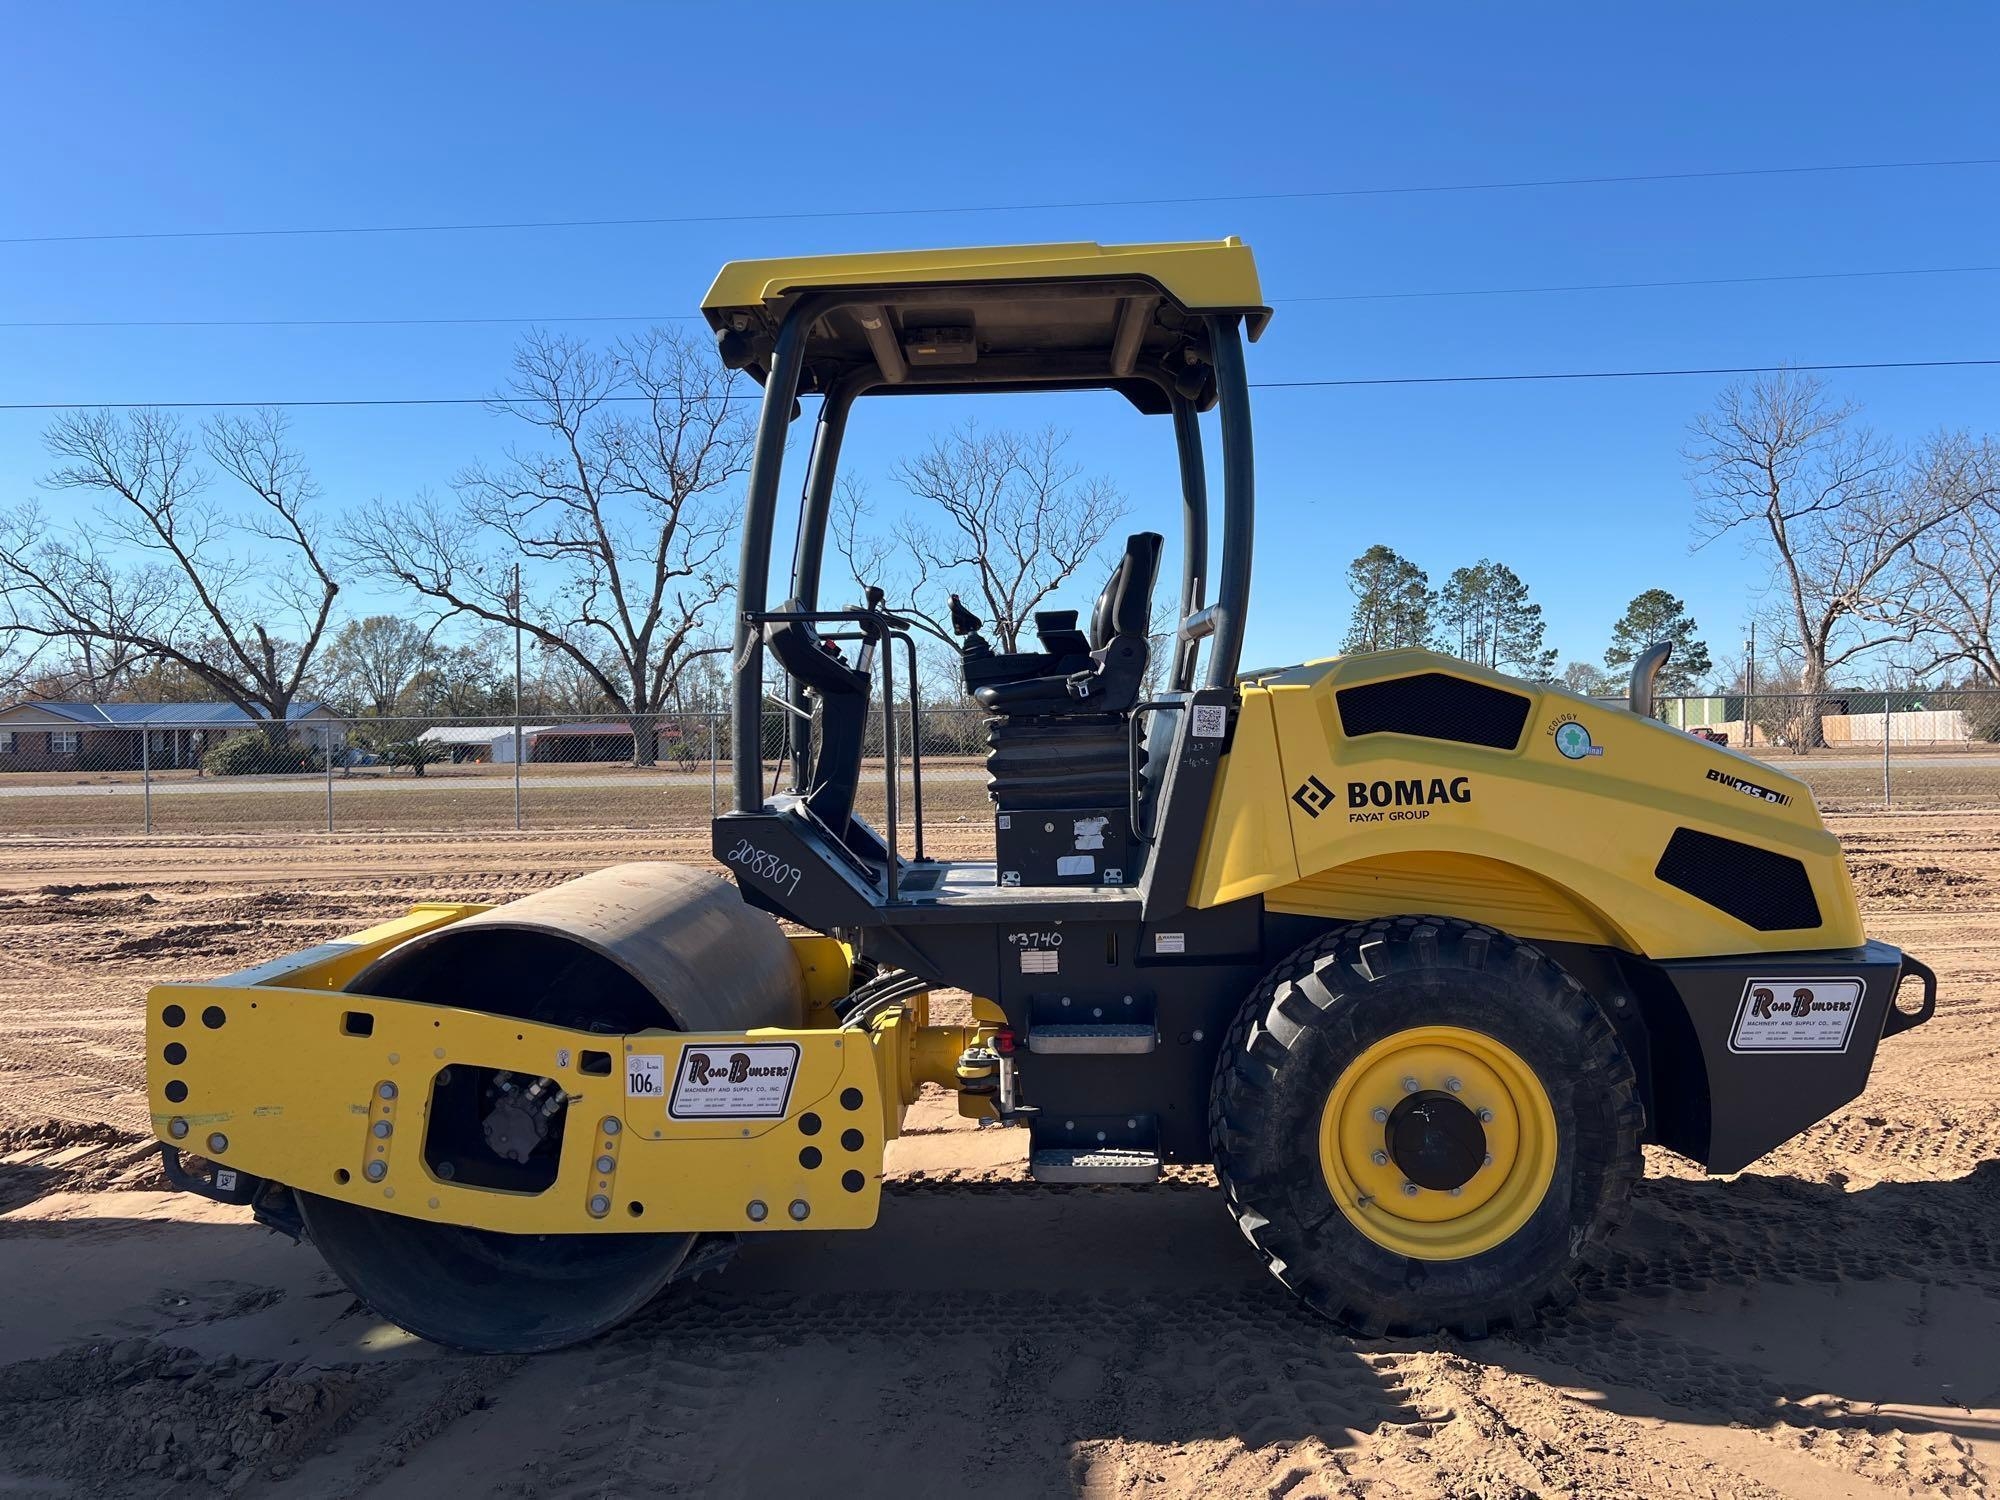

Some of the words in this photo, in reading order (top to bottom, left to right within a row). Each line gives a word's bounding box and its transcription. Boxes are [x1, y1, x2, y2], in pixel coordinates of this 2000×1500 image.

[1546, 712, 1578, 737] ECOLOGY
[1347, 776, 1472, 808] BOMAG
[1349, 812, 1385, 823] FAYAT
[1389, 810, 1430, 821] GROUP
[727, 838, 801, 897] 208809
[1007, 931, 1063, 947] #3740
[1752, 987, 1791, 1020] ROAD
[1791, 987, 1852, 1018] BUILDERS
[629, 1073, 653, 1093] 106
[689, 1052, 728, 1086] ROAD
[729, 1052, 789, 1084] BUILDERS
